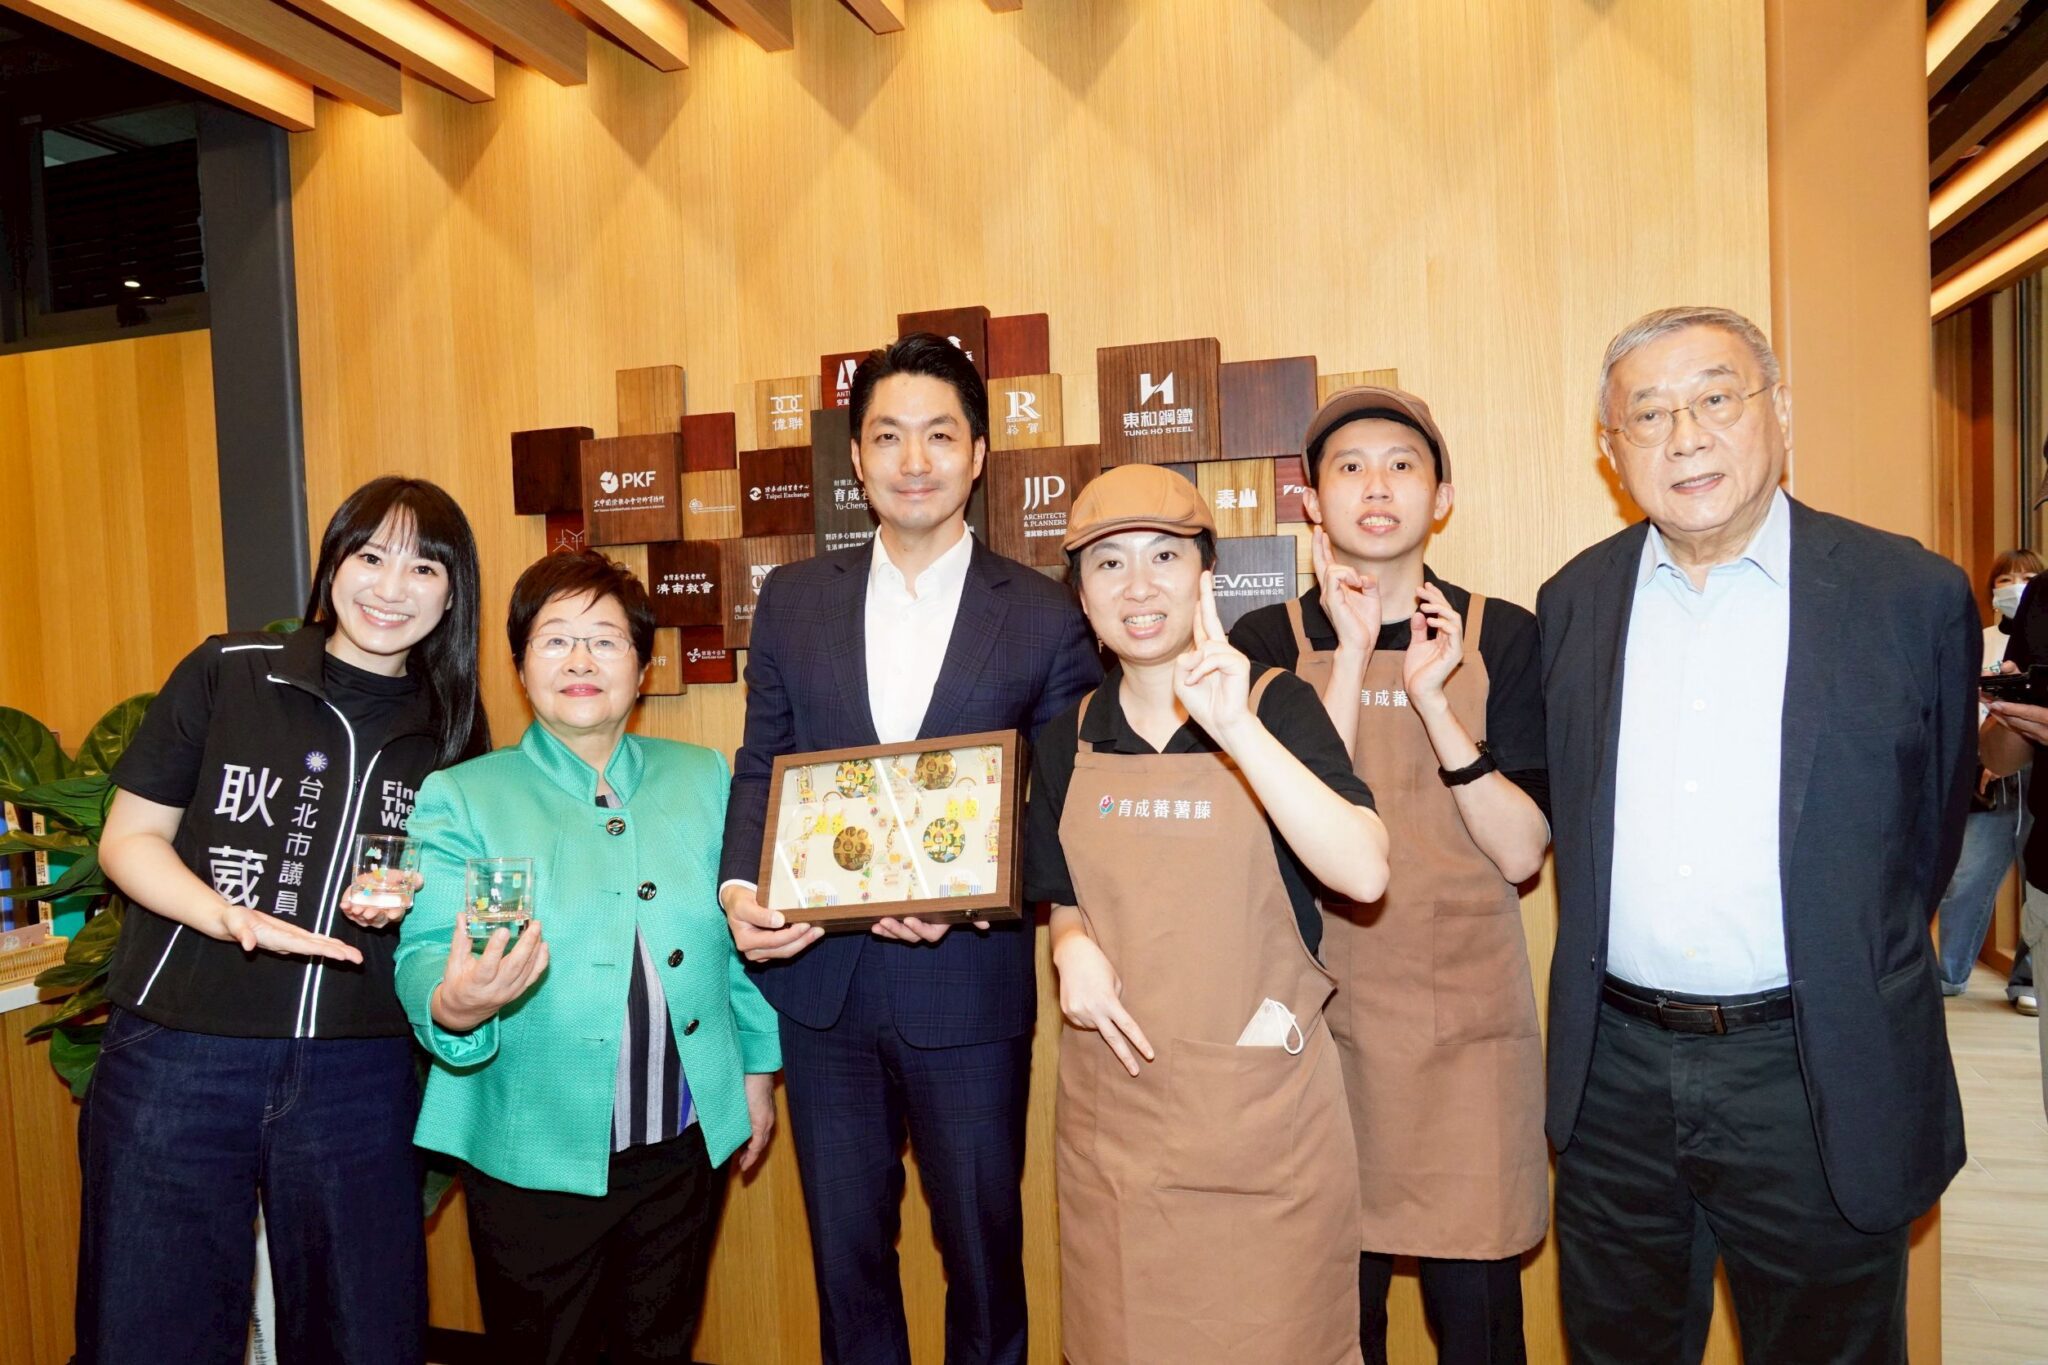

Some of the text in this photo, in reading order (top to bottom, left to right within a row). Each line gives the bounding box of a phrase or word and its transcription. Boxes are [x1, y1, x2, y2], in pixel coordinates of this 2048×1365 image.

[1123, 408, 1193, 429] 東和鋼鐵
[1124, 429, 1148, 437] TUNG
[1165, 426, 1194, 434] STEEL
[622, 471, 656, 489] PKF
[765, 492, 810, 501] Taipei Exchange
[1023, 475, 1065, 510] JJP
[1215, 488, 1258, 509] 泰山
[835, 502, 868, 511] Yu-Cheng
[1023, 512, 1067, 520] ARCHITECTS
[1030, 519, 1067, 527] PLANNERS
[1117, 798, 1212, 819] 育成蕃薯藤
[272, 775, 325, 917] 台北市議員
